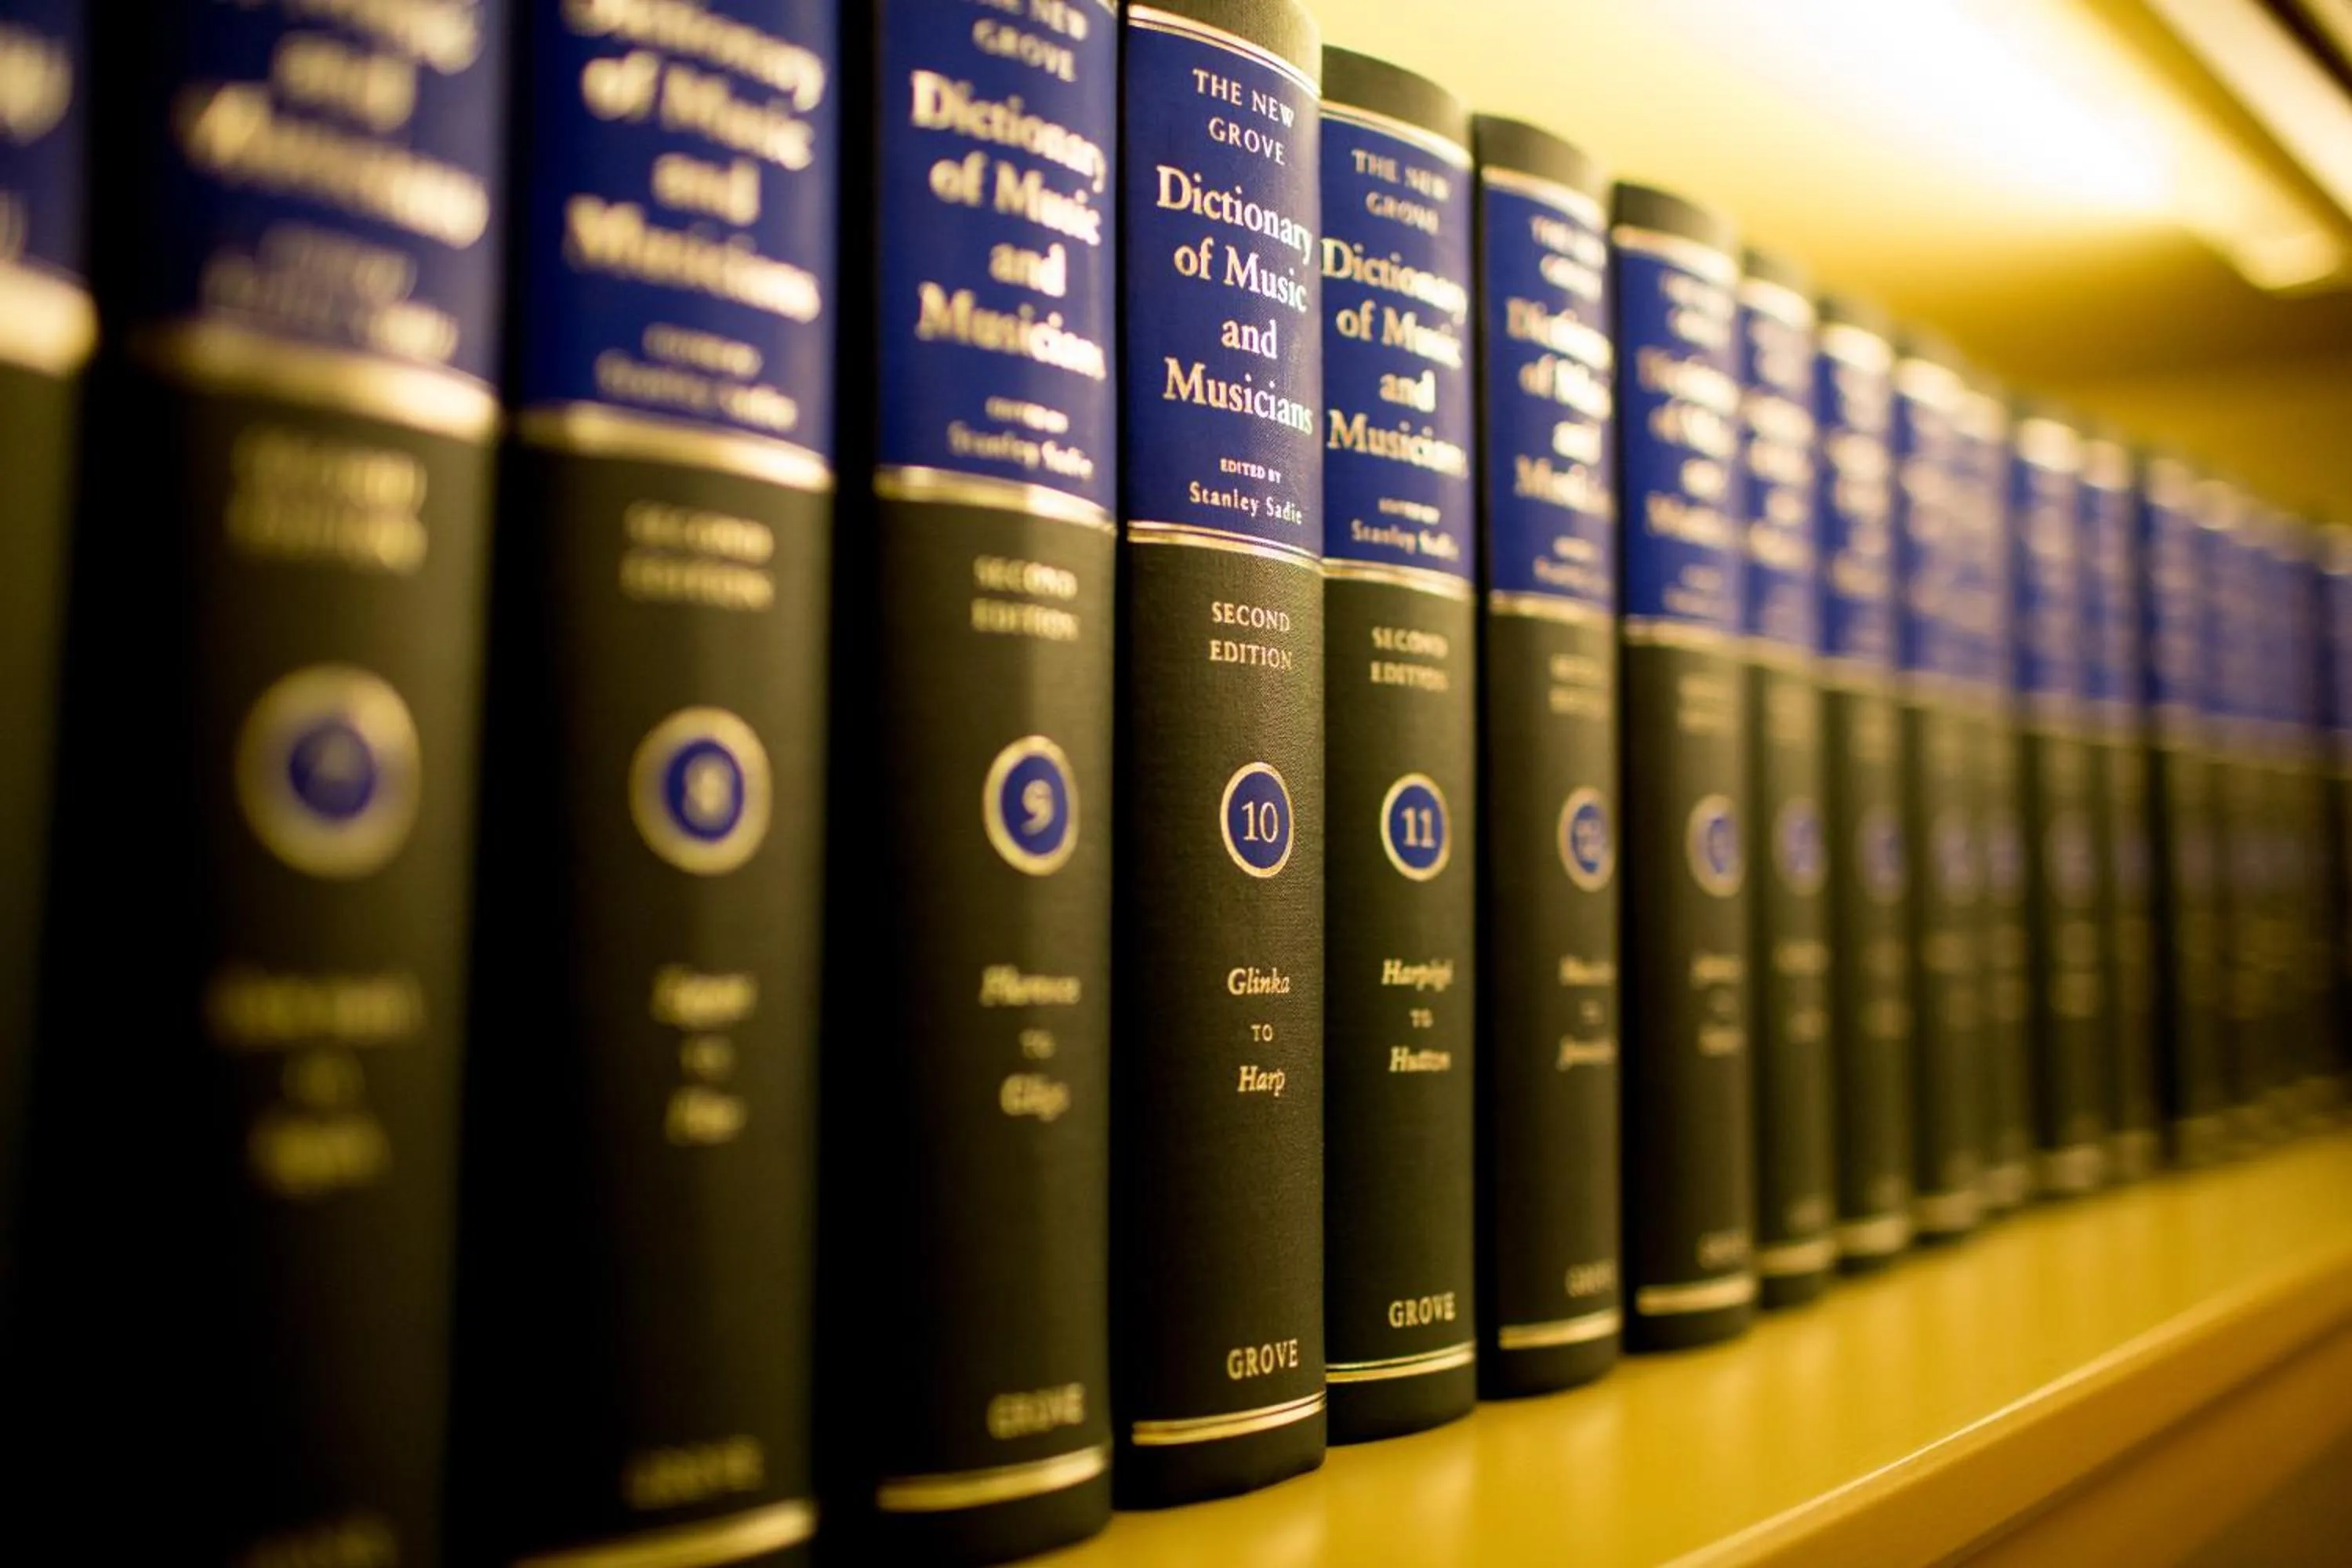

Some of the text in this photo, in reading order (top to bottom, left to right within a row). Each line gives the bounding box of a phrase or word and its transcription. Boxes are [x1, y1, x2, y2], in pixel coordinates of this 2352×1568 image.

[1192, 68, 1294, 128] THE NEW
[1208, 117, 1285, 165] GROVE
[929, 151, 987, 207] of
[1156, 164, 1313, 265] Dictionary
[1174, 237, 1307, 313] of Music
[1319, 237, 1468, 326] Dictionary
[1221, 319, 1277, 359] and
[1336, 299, 1376, 341] of
[1381, 307, 1463, 368] Music
[1163, 356, 1313, 434] Musicians
[1378, 369, 1436, 412] and
[1327, 408, 1470, 481] Musicians
[1220, 458, 1282, 483] EDITED BY
[1189, 481, 1302, 525] Stanley Sadie
[1211, 601, 1290, 631] SECOND
[1209, 640, 1293, 670] EDITION
[1021, 779, 1054, 837] 9
[1241, 801, 1279, 843] 10
[1401, 807, 1436, 848] 11
[1227, 967, 1290, 996] Glinka
[1250, 1024, 1273, 1042] TO
[1237, 1065, 1286, 1096] Harp
[1388, 1291, 1456, 1329] GROVE
[1228, 1339, 1298, 1380] GROVE
